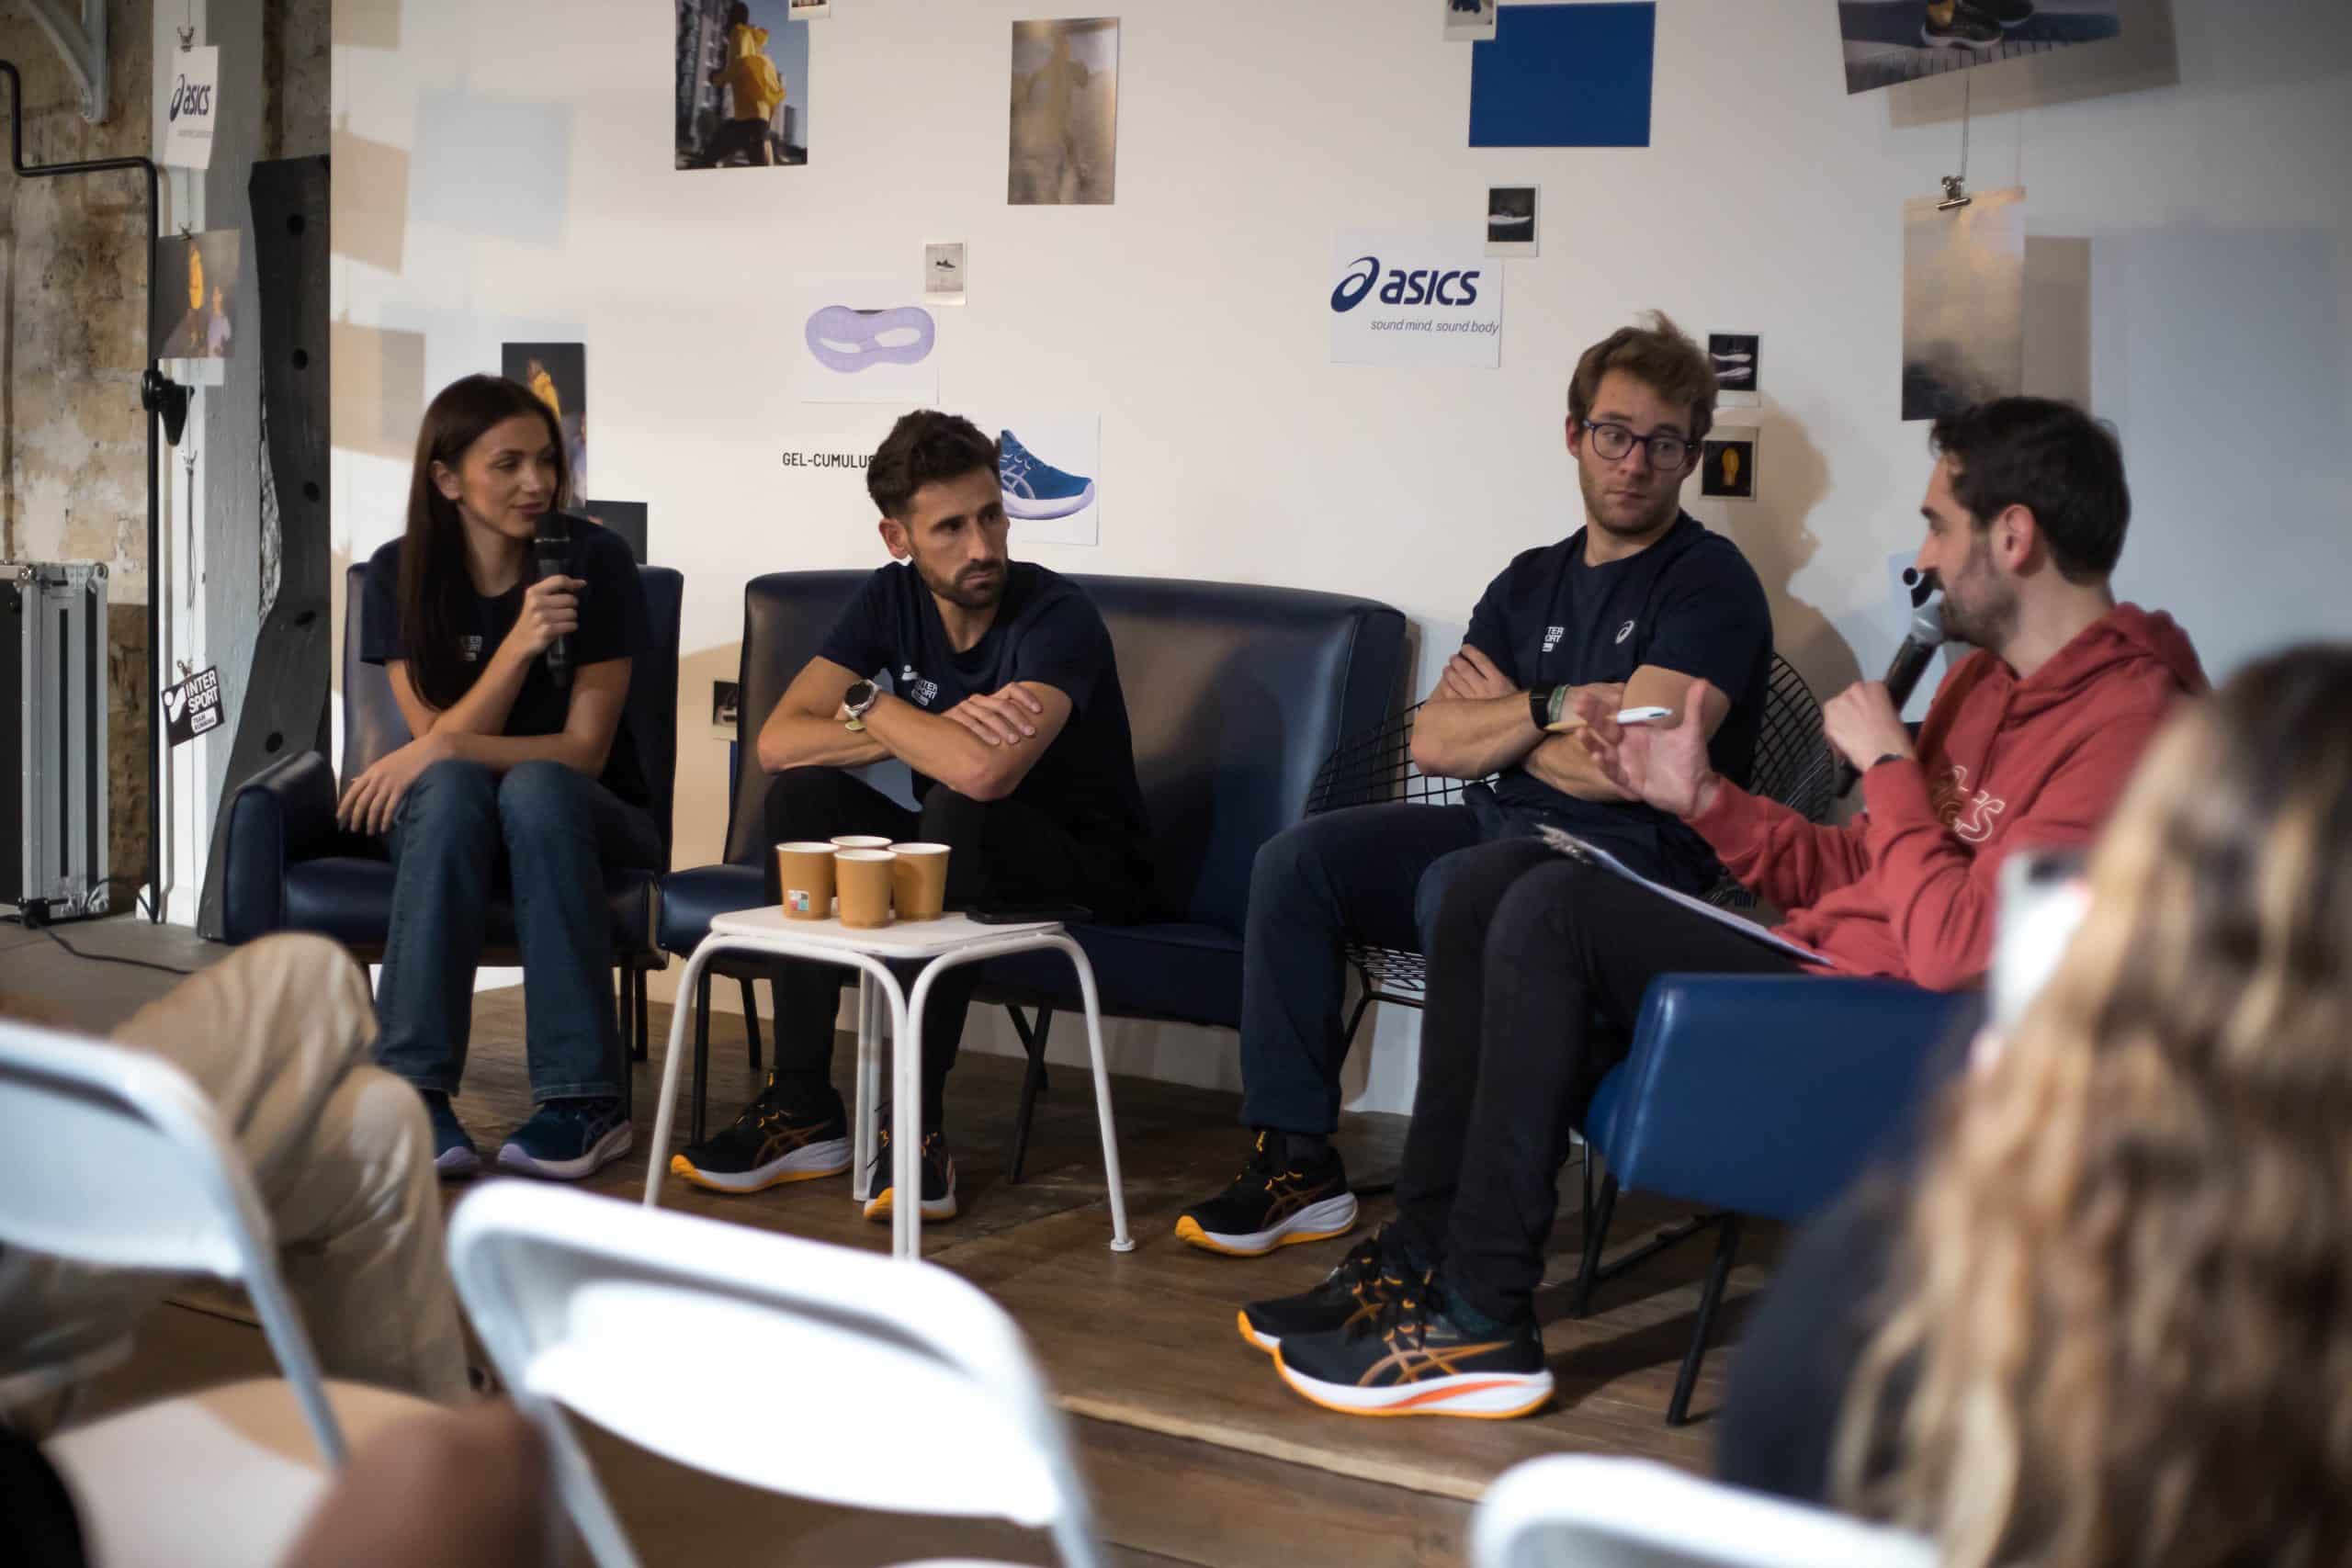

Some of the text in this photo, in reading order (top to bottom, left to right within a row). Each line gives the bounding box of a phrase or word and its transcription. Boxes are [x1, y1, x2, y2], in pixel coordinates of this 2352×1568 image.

[183, 84, 211, 117] asics
[1379, 269, 1481, 307] asics
[1371, 319, 1405, 332] sound
[1435, 320, 1471, 333] sound
[1471, 320, 1499, 336] body
[185, 670, 217, 699] INTER
[187, 686, 218, 714] SPORT
